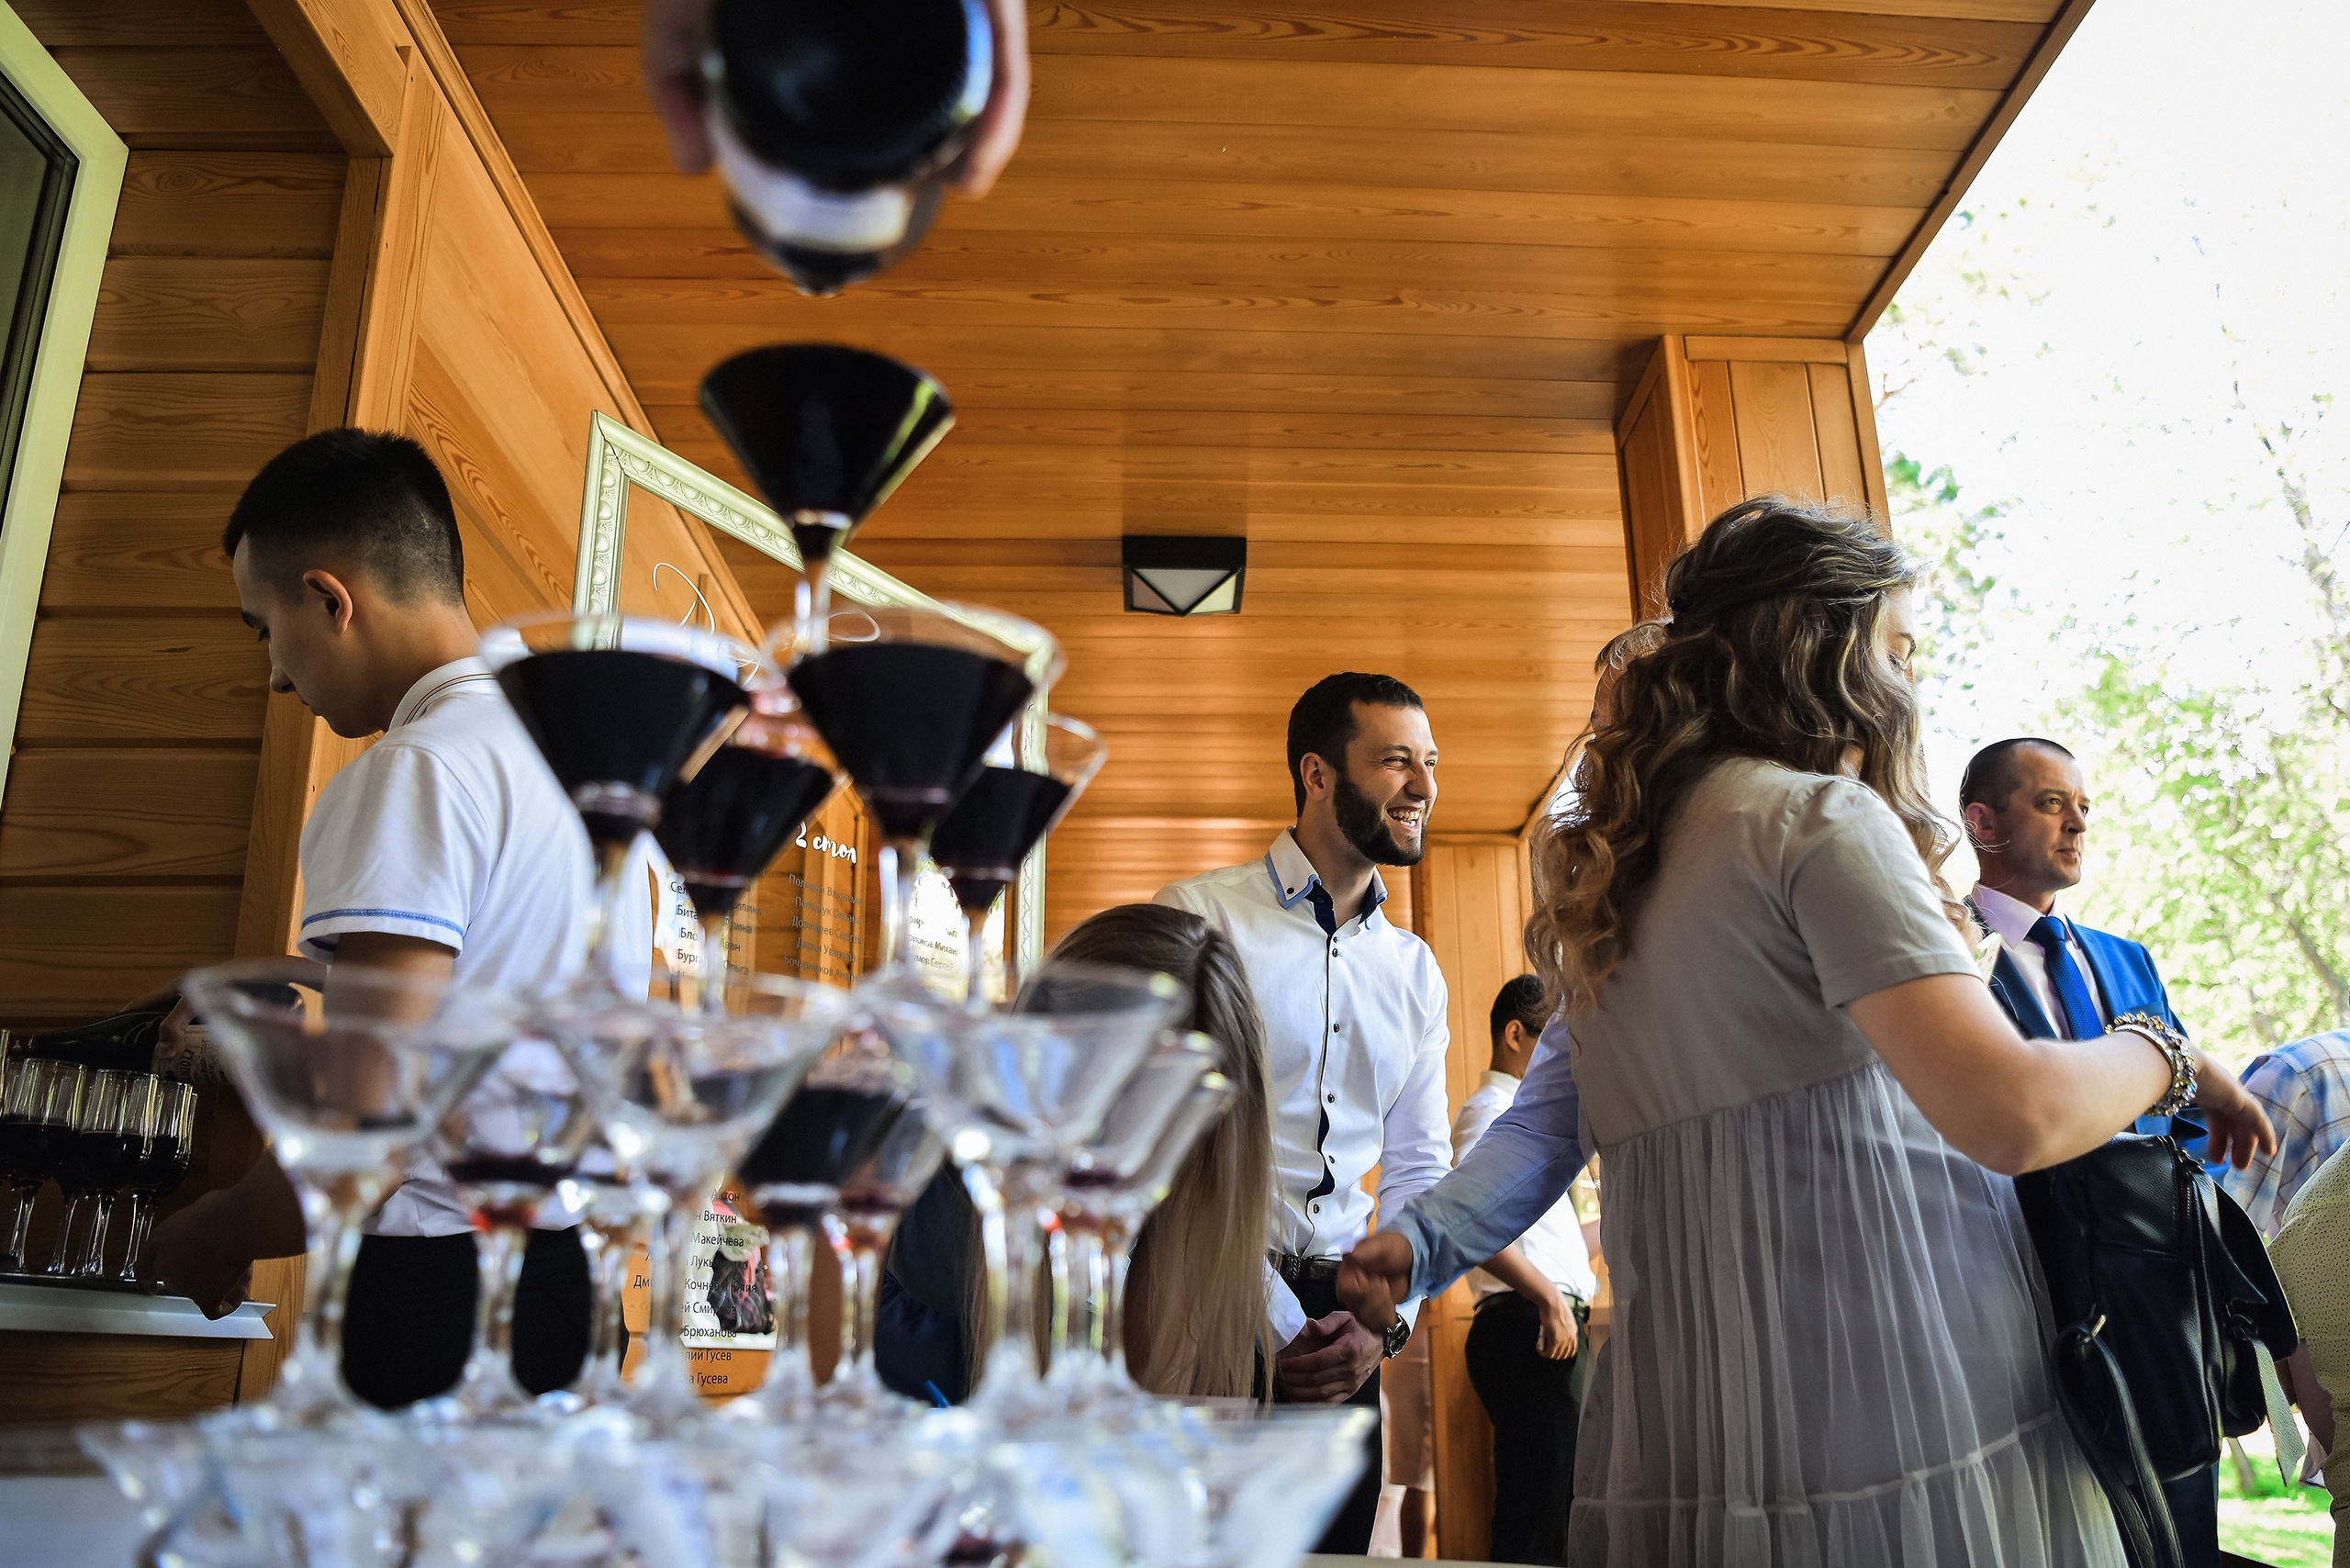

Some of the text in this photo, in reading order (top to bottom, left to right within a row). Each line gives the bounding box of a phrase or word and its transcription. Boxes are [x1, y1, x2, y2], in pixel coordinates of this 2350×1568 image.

[704, 1210, 737, 1224] Вяткин
[691, 1232, 744, 1248] Макейчева
[683, 1325, 737, 1339] Брюханова
[706, 1349, 732, 1364] Гусев
[697, 1372, 728, 1387] Гусева
